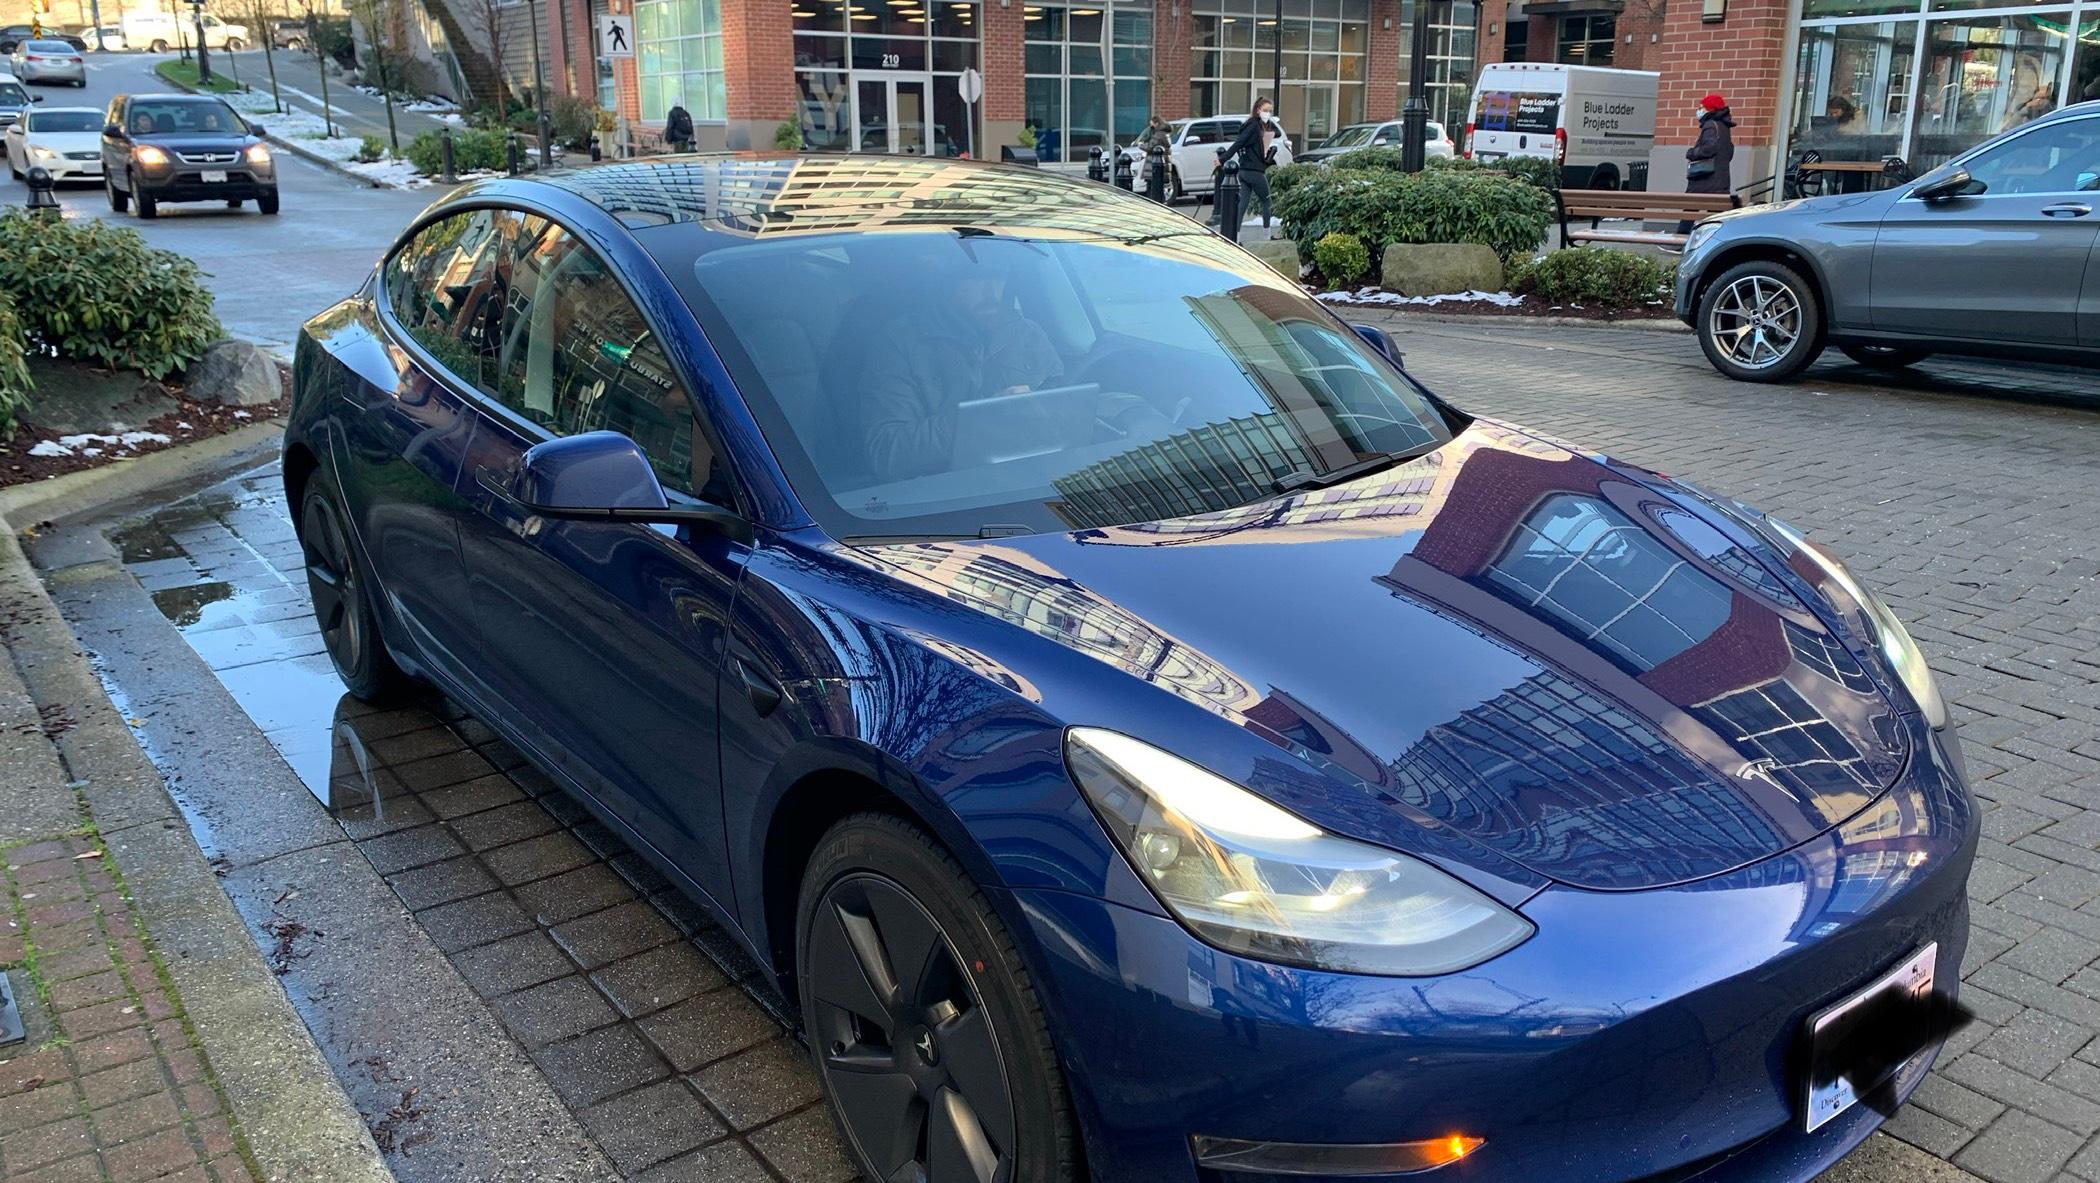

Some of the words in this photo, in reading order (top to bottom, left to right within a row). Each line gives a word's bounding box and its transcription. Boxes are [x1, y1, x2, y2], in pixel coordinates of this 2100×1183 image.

[882, 54, 900, 65] 210
[1520, 97, 1533, 105] Blue
[1534, 98, 1556, 106] Ladder
[1519, 105, 1544, 113] Projects
[1584, 101, 1602, 114] Blue
[1604, 103, 1635, 116] Ladder
[1583, 117, 1619, 131] Projects
